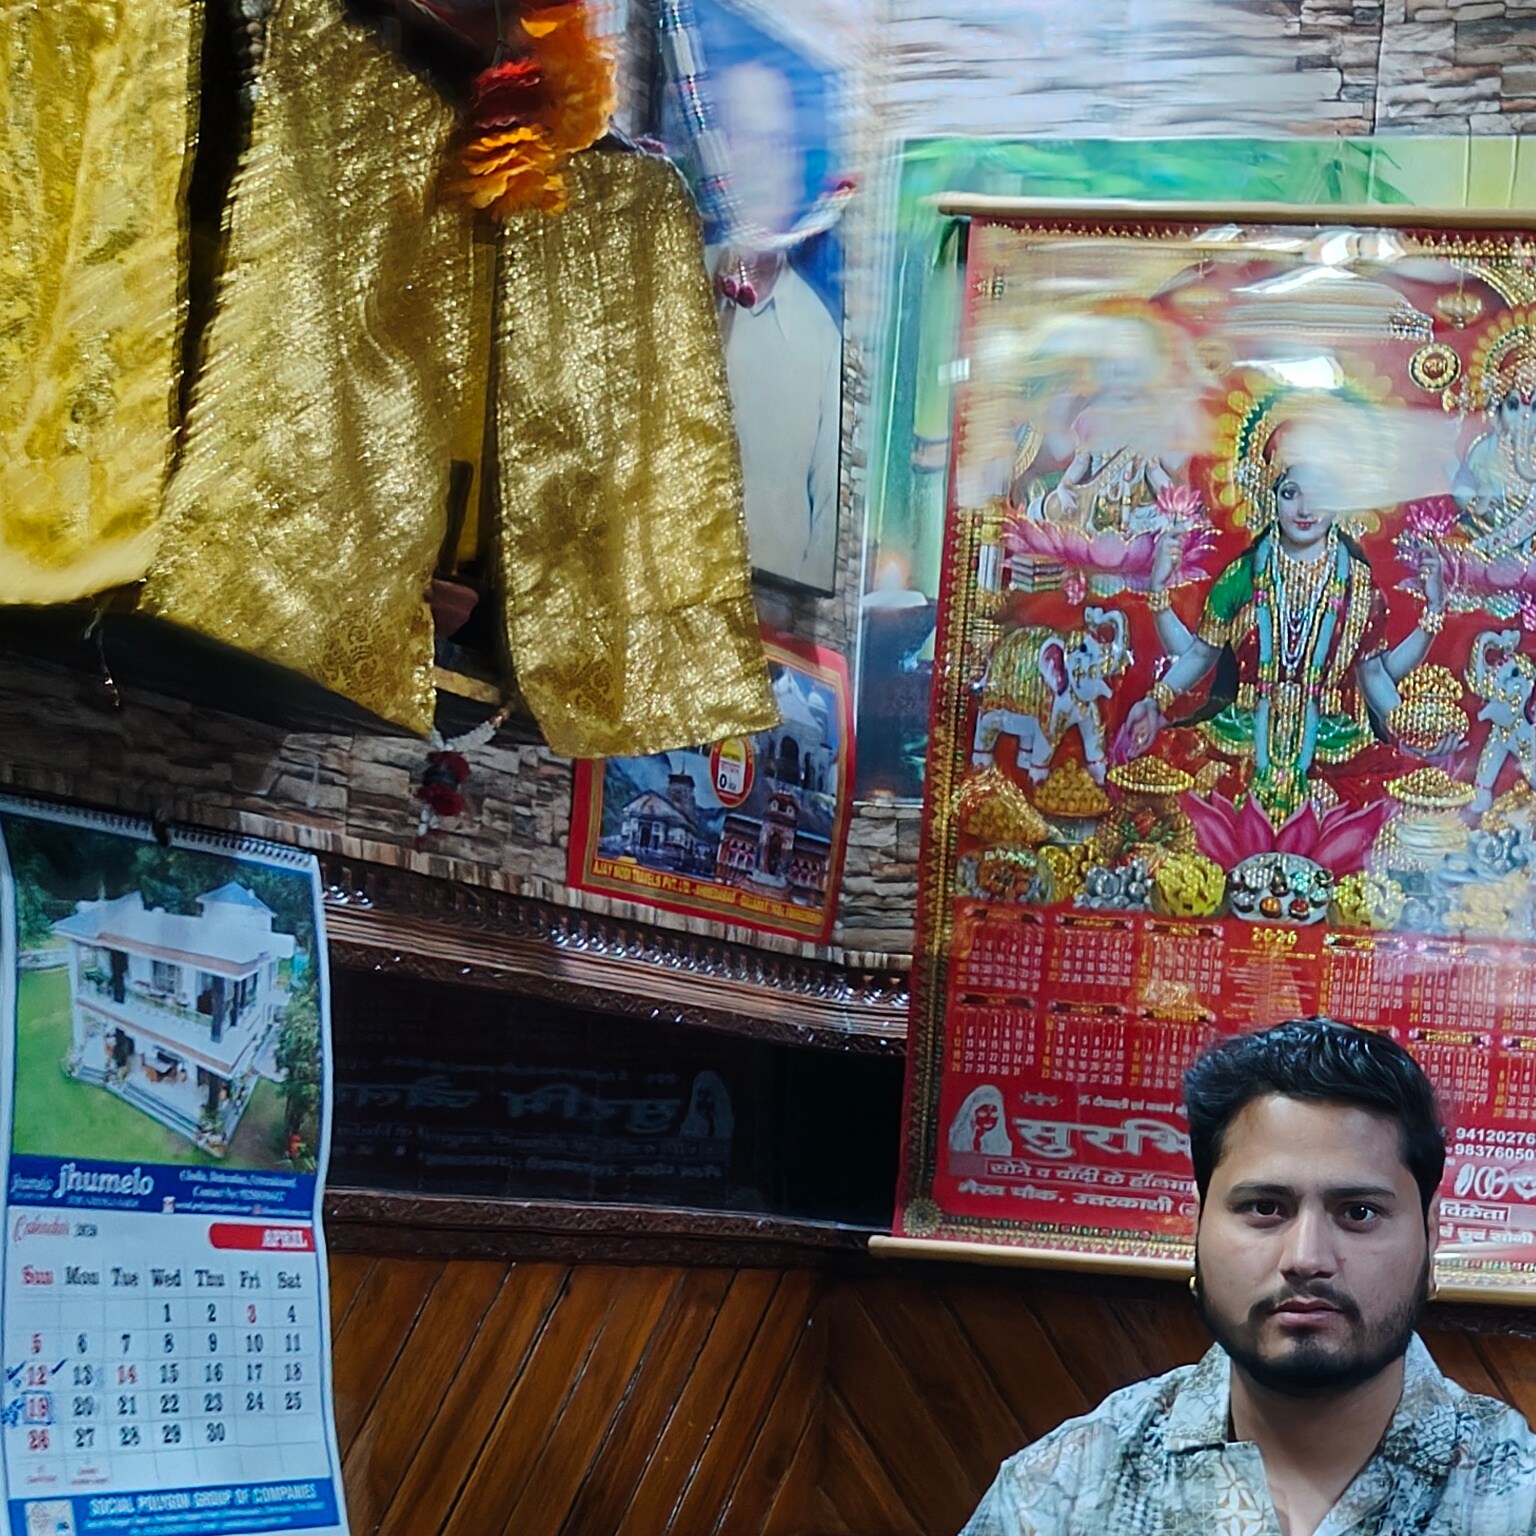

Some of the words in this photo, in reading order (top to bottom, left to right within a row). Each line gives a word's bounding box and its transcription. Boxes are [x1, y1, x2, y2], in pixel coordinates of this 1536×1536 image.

[22, 1265, 53, 1284] Sun
[65, 1266, 99, 1285] Mon
[110, 1267, 139, 1287] Tue
[151, 1269, 181, 1288] Wed
[195, 1269, 225, 1287] Thu
[239, 1270, 261, 1289] Fri
[277, 1271, 302, 1289] Sat
[164, 1303, 171, 1322] 1
[208, 1303, 216, 1322] 2
[247, 1304, 257, 1323] 3
[287, 1304, 296, 1322] 4
[32, 1333, 41, 1354] 5
[77, 1333, 87, 1354] 6
[121, 1334, 130, 1354] 7
[164, 1333, 174, 1353] 8
[208, 1333, 217, 1352] 9
[246, 1334, 263, 1352] 10
[286, 1334, 301, 1352] 11
[27, 1365, 47, 1386] 12
[74, 1365, 93, 1385] 13
[118, 1365, 137, 1385] 14
[160, 1363, 179, 1383] 15
[205, 1363, 223, 1382] 16
[247, 1363, 262, 1382] 17
[285, 1363, 302, 1381] 18
[29, 1397, 49, 1417] 19
[73, 1396, 94, 1416] 20
[118, 1395, 136, 1415] 21
[161, 1394, 179, 1413] 22
[205, 1393, 223, 1412] 23
[246, 1392, 264, 1411] 24
[285, 1391, 302, 1410] 25
[28, 1429, 49, 1450] 26
[75, 1428, 95, 1447] 27
[120, 1426, 140, 1446] 28
[162, 1424, 181, 1444] 29
[206, 1422, 225, 1442] 30
